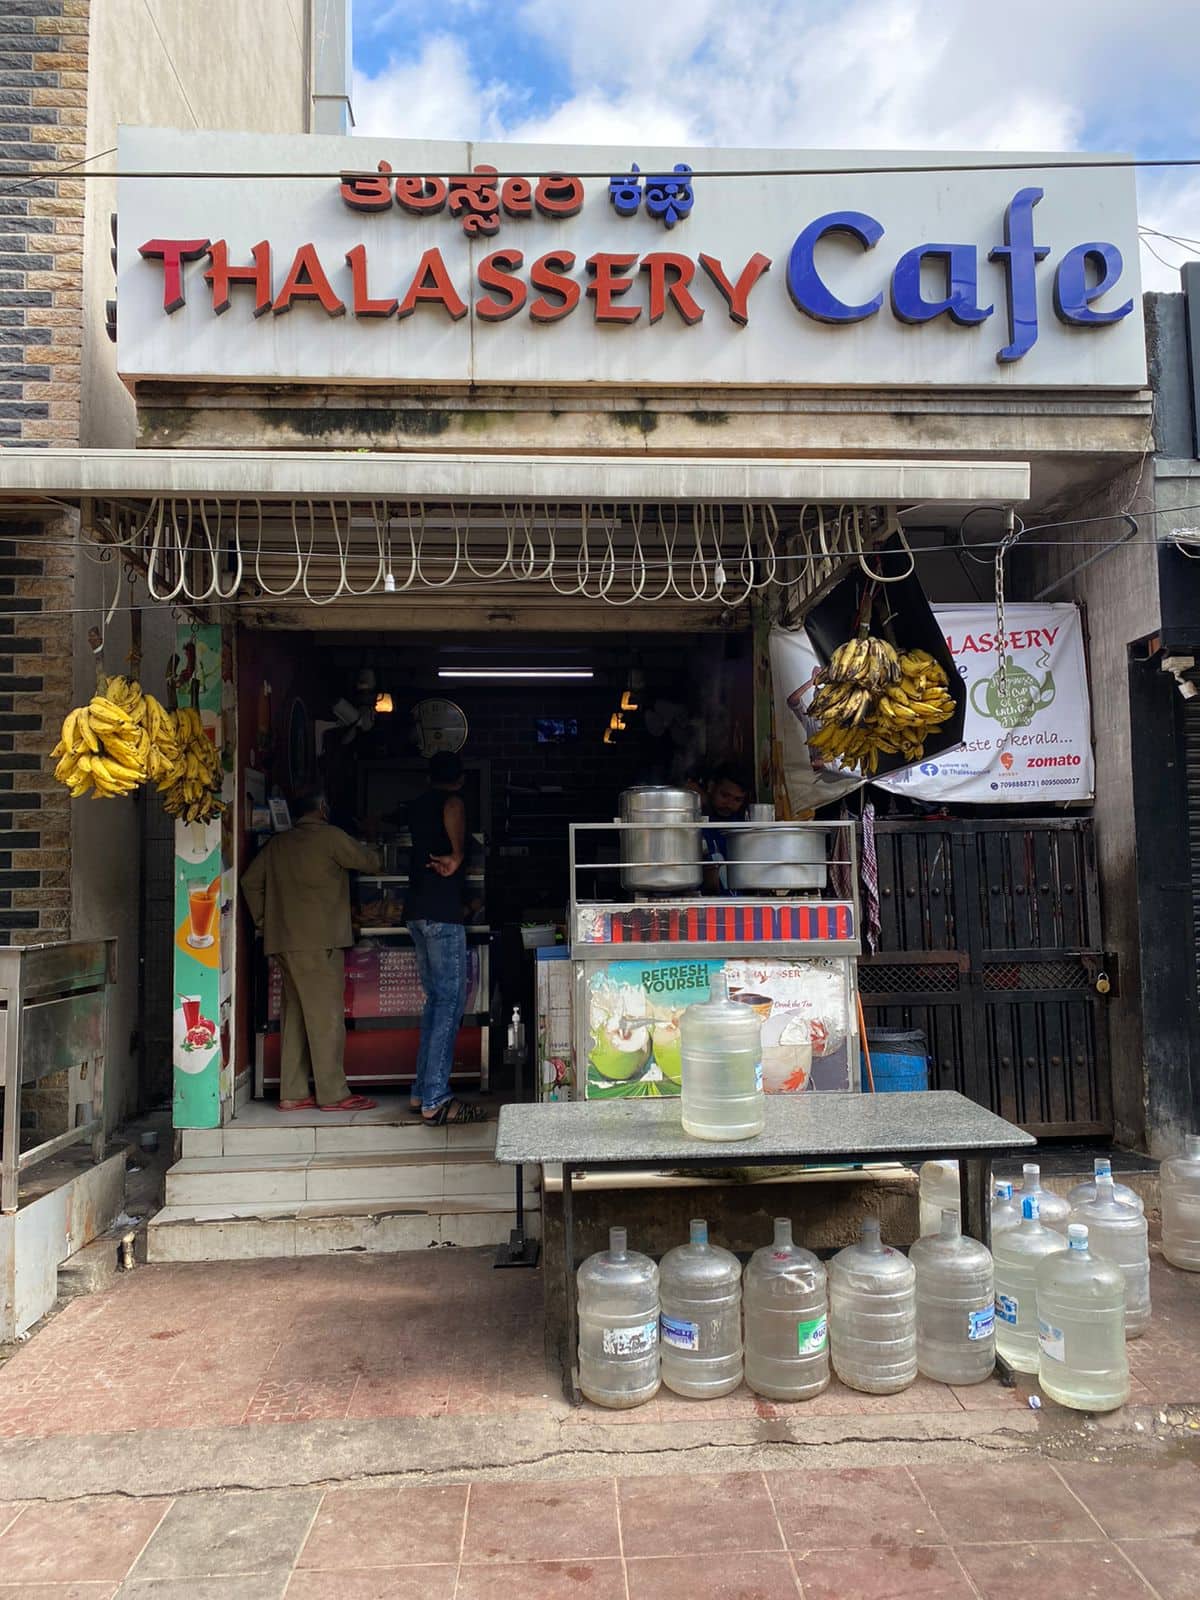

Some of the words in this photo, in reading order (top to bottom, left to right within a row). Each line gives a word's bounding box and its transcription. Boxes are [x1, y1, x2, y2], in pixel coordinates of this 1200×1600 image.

[138, 239, 771, 326] THALASSERY
[786, 187, 1133, 362] Cafe
[1027, 754, 1081, 768] zomato
[641, 964, 708, 984] REFRESH
